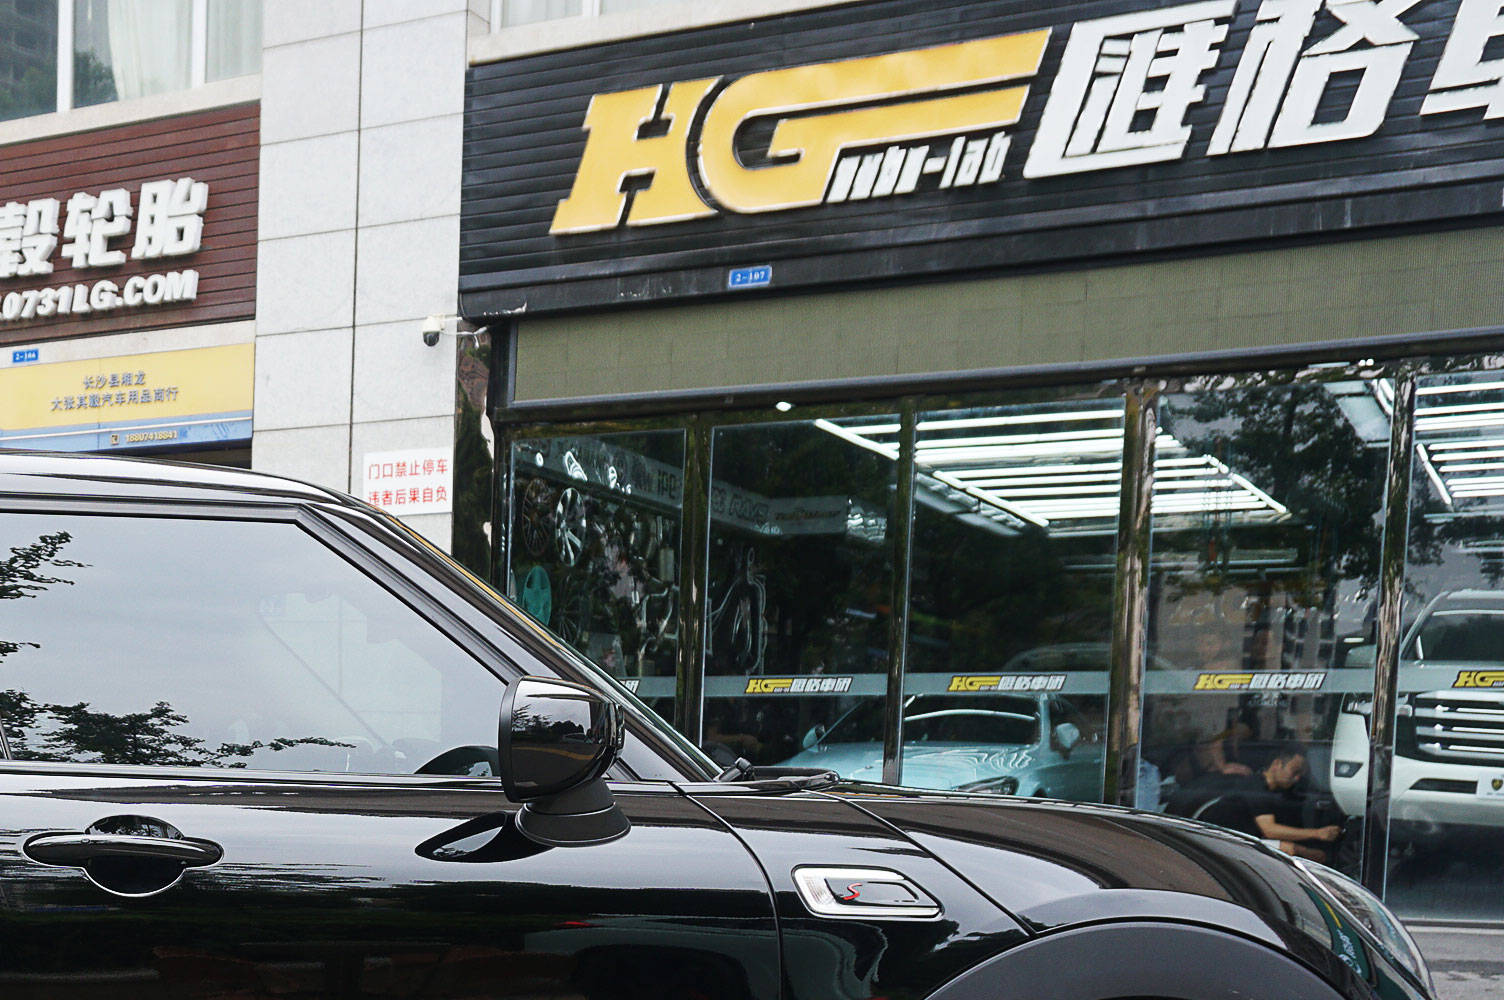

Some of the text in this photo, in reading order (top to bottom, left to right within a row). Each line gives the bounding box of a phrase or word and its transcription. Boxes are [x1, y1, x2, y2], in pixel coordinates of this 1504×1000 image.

[549, 27, 1053, 235] HG
[735, 271, 766, 282] 2-107
[368, 458, 449, 480] 门口禁止停车
[368, 486, 448, 506] 违者后果自负
